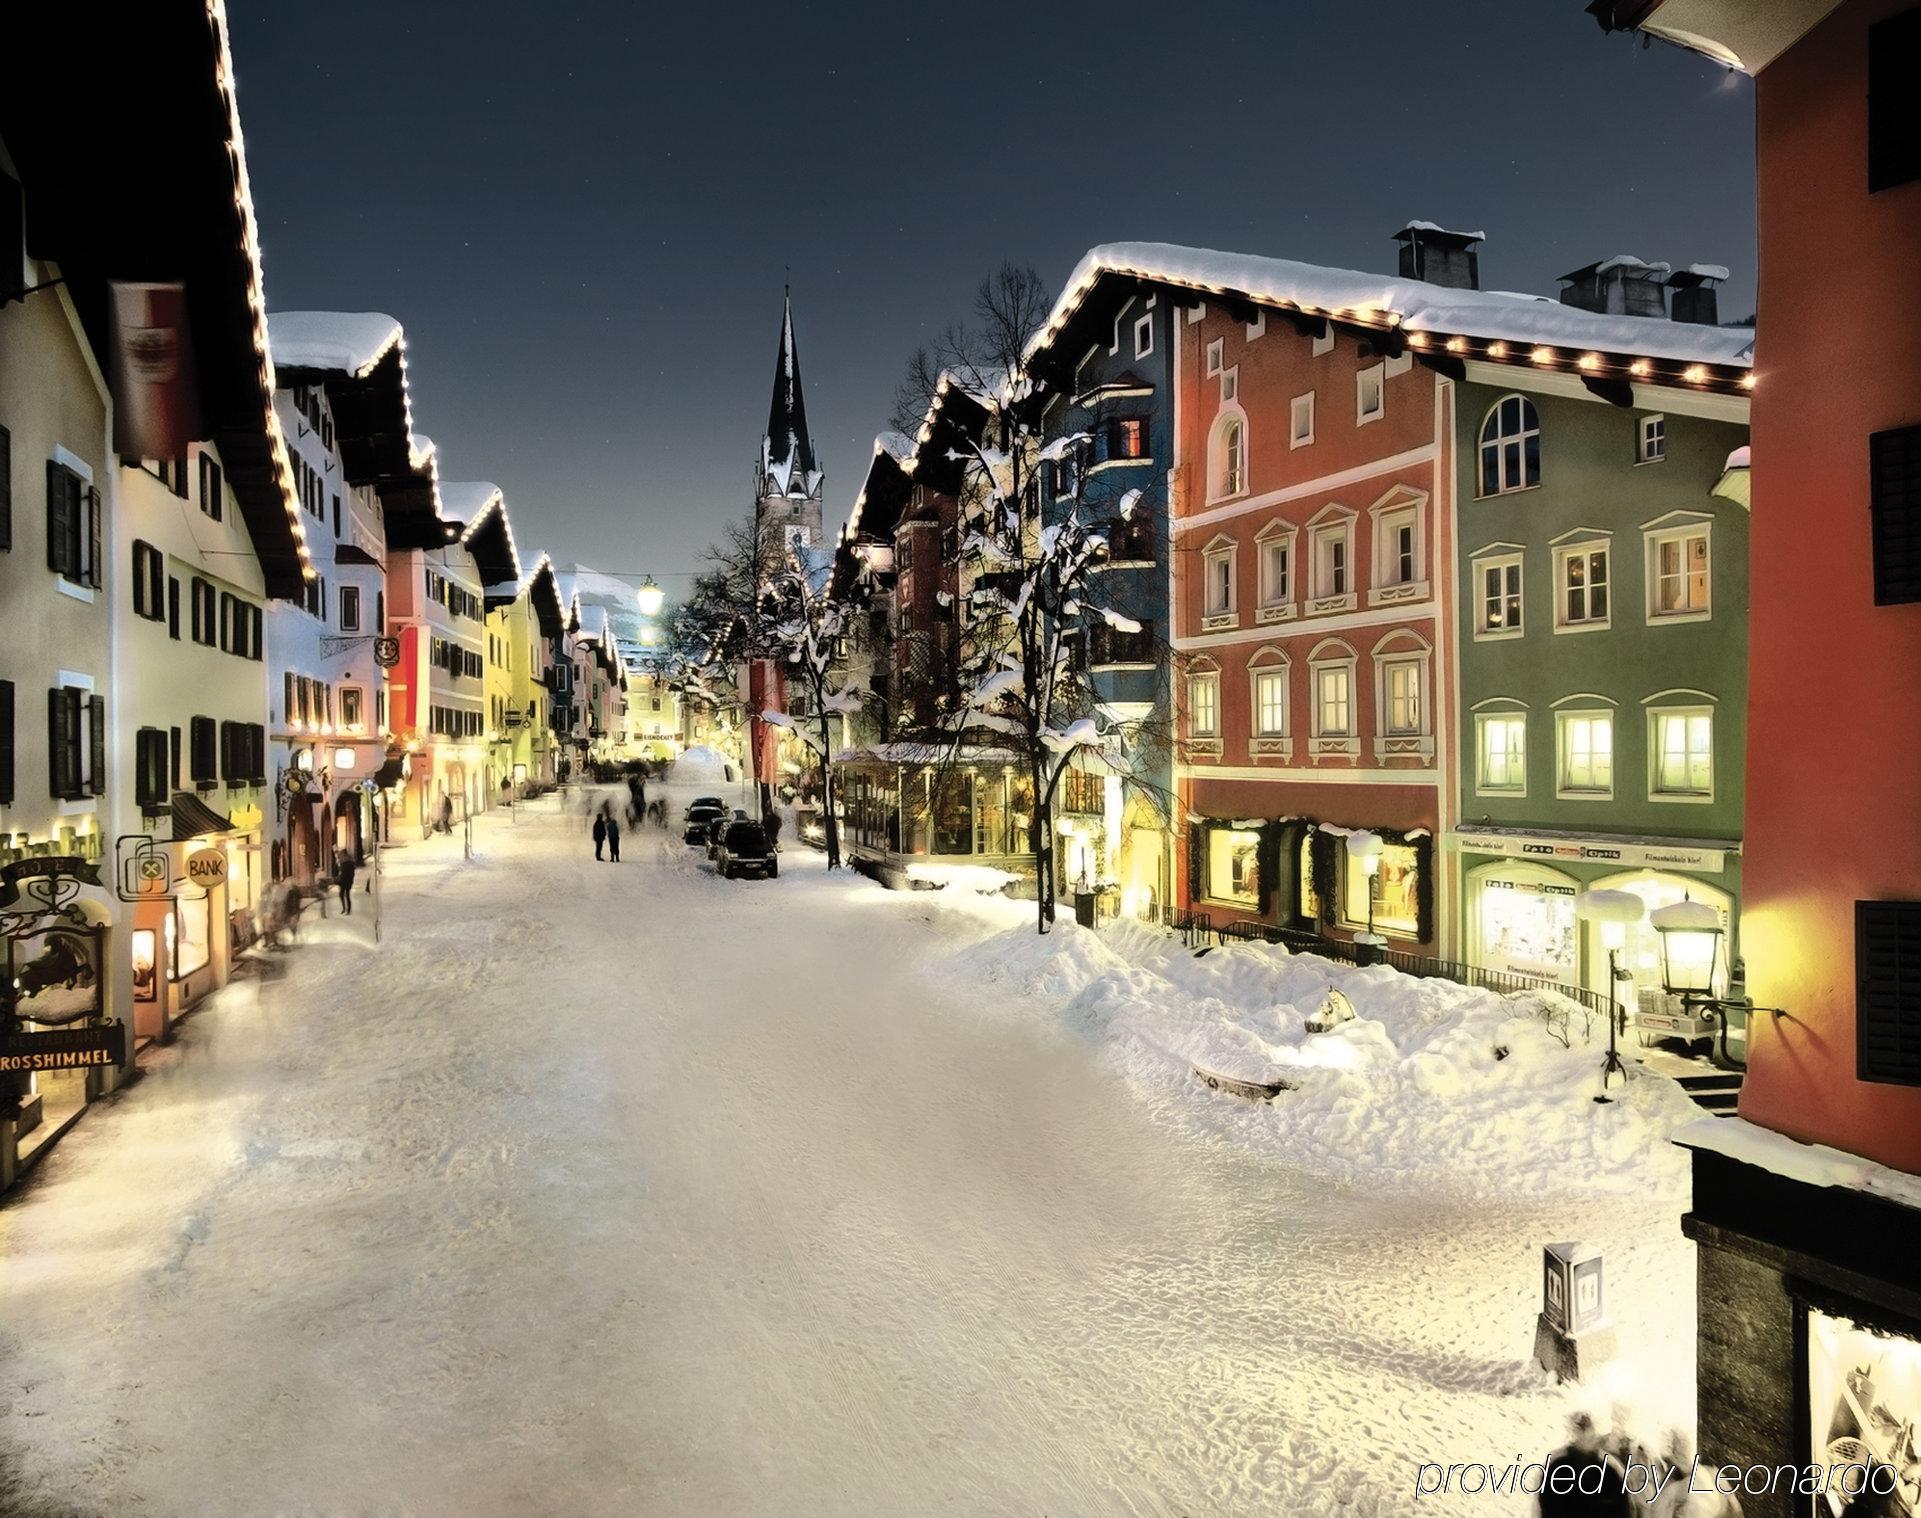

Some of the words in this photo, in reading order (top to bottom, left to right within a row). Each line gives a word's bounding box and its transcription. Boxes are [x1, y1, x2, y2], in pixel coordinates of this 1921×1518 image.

[1588, 849, 1619, 859] Optik
[190, 860, 223, 876] BANK
[0, 1049, 112, 1070] ROSSHIMMEL
